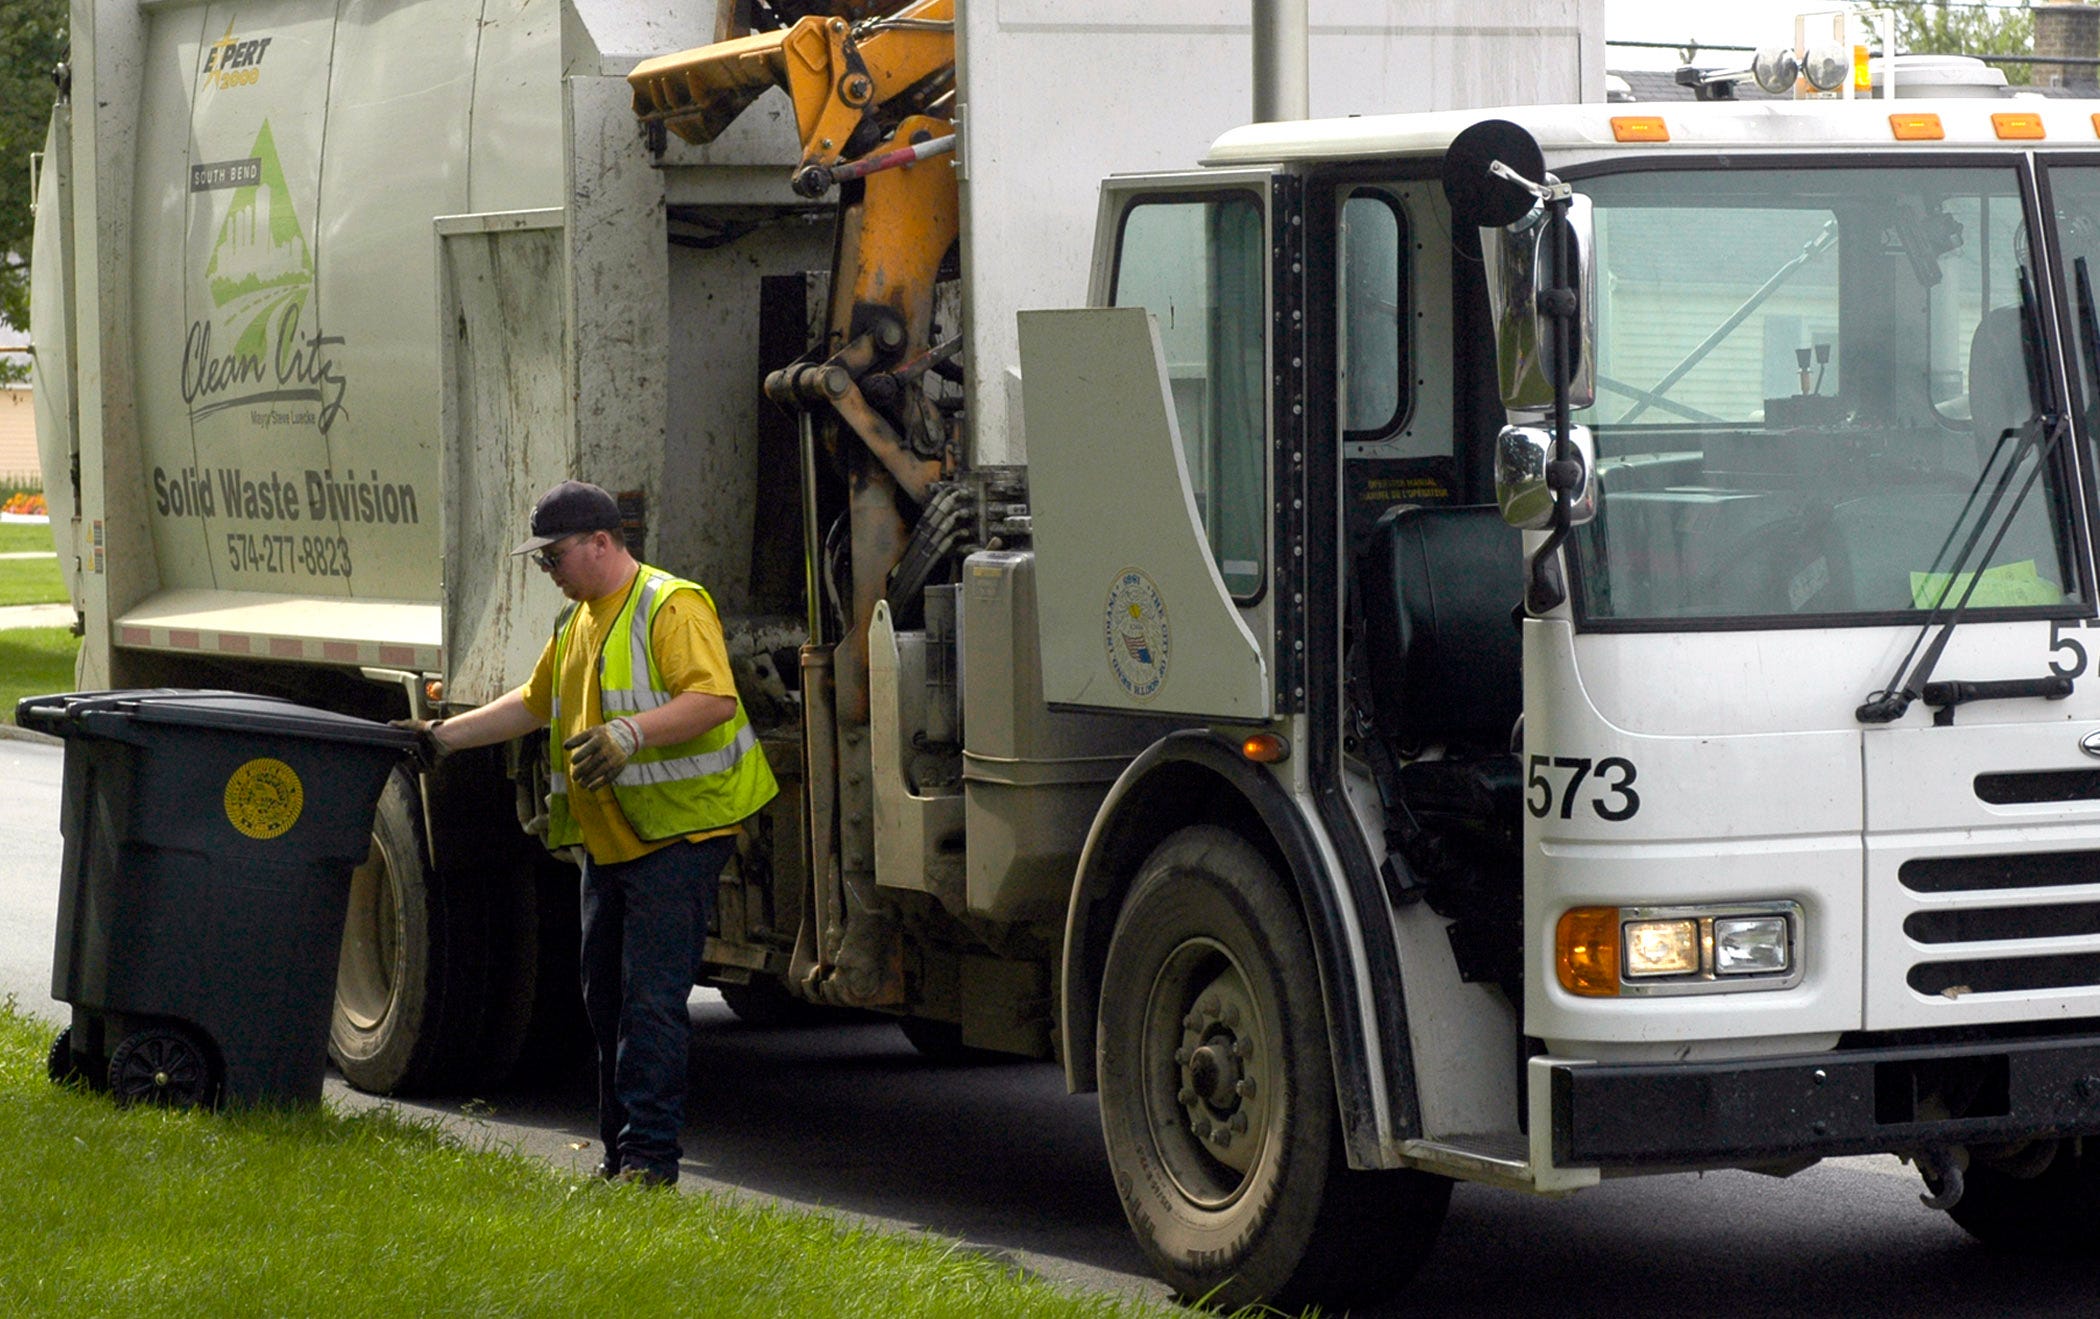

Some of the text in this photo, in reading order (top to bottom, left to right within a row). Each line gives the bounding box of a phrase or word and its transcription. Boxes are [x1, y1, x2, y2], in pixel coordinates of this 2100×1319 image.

[220, 67, 259, 89] 2000
[194, 164, 257, 185] SOUTH BEND
[181, 303, 349, 435] Clean City
[153, 466, 419, 524] Solid Waste Division
[226, 533, 353, 577] 574-277-8823
[1527, 754, 1640, 822] 573
